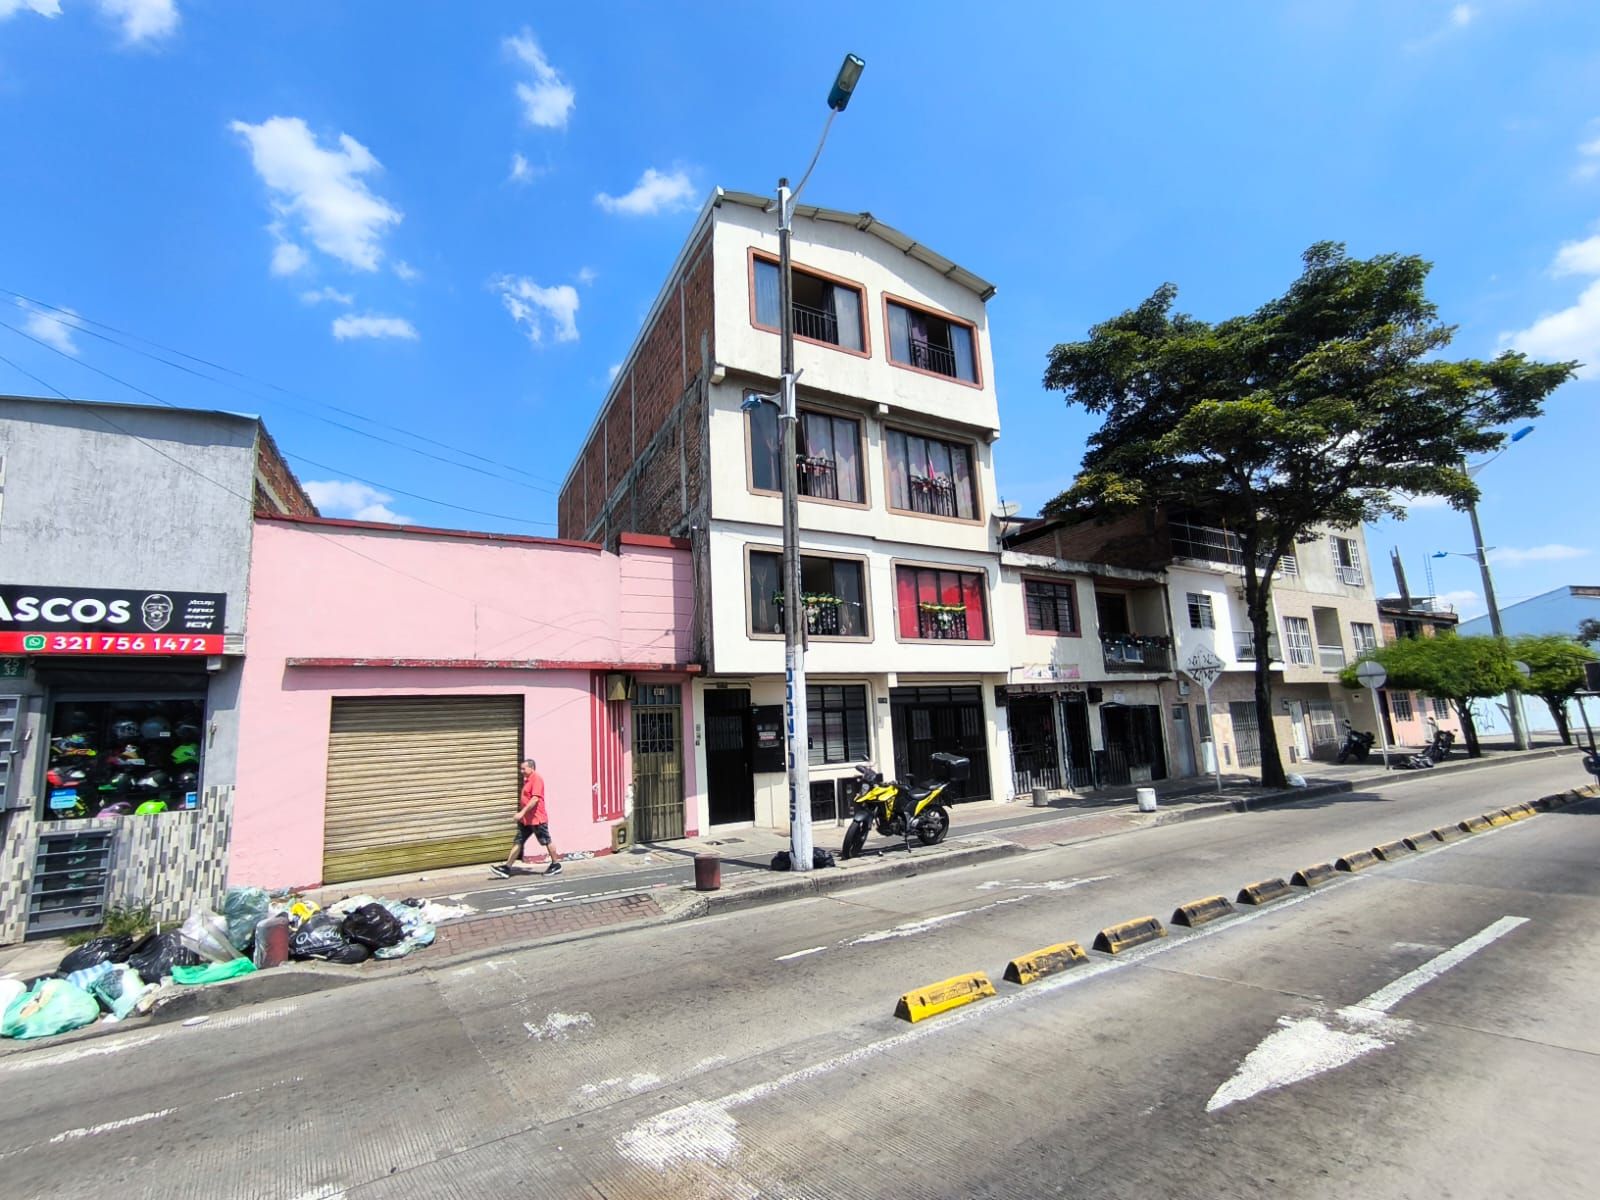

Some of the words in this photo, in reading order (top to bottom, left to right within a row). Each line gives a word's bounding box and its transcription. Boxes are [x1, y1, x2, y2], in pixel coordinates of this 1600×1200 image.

[53, 636, 92, 650] 321
[101, 637, 145, 650] 756
[153, 638, 207, 651] 1472
